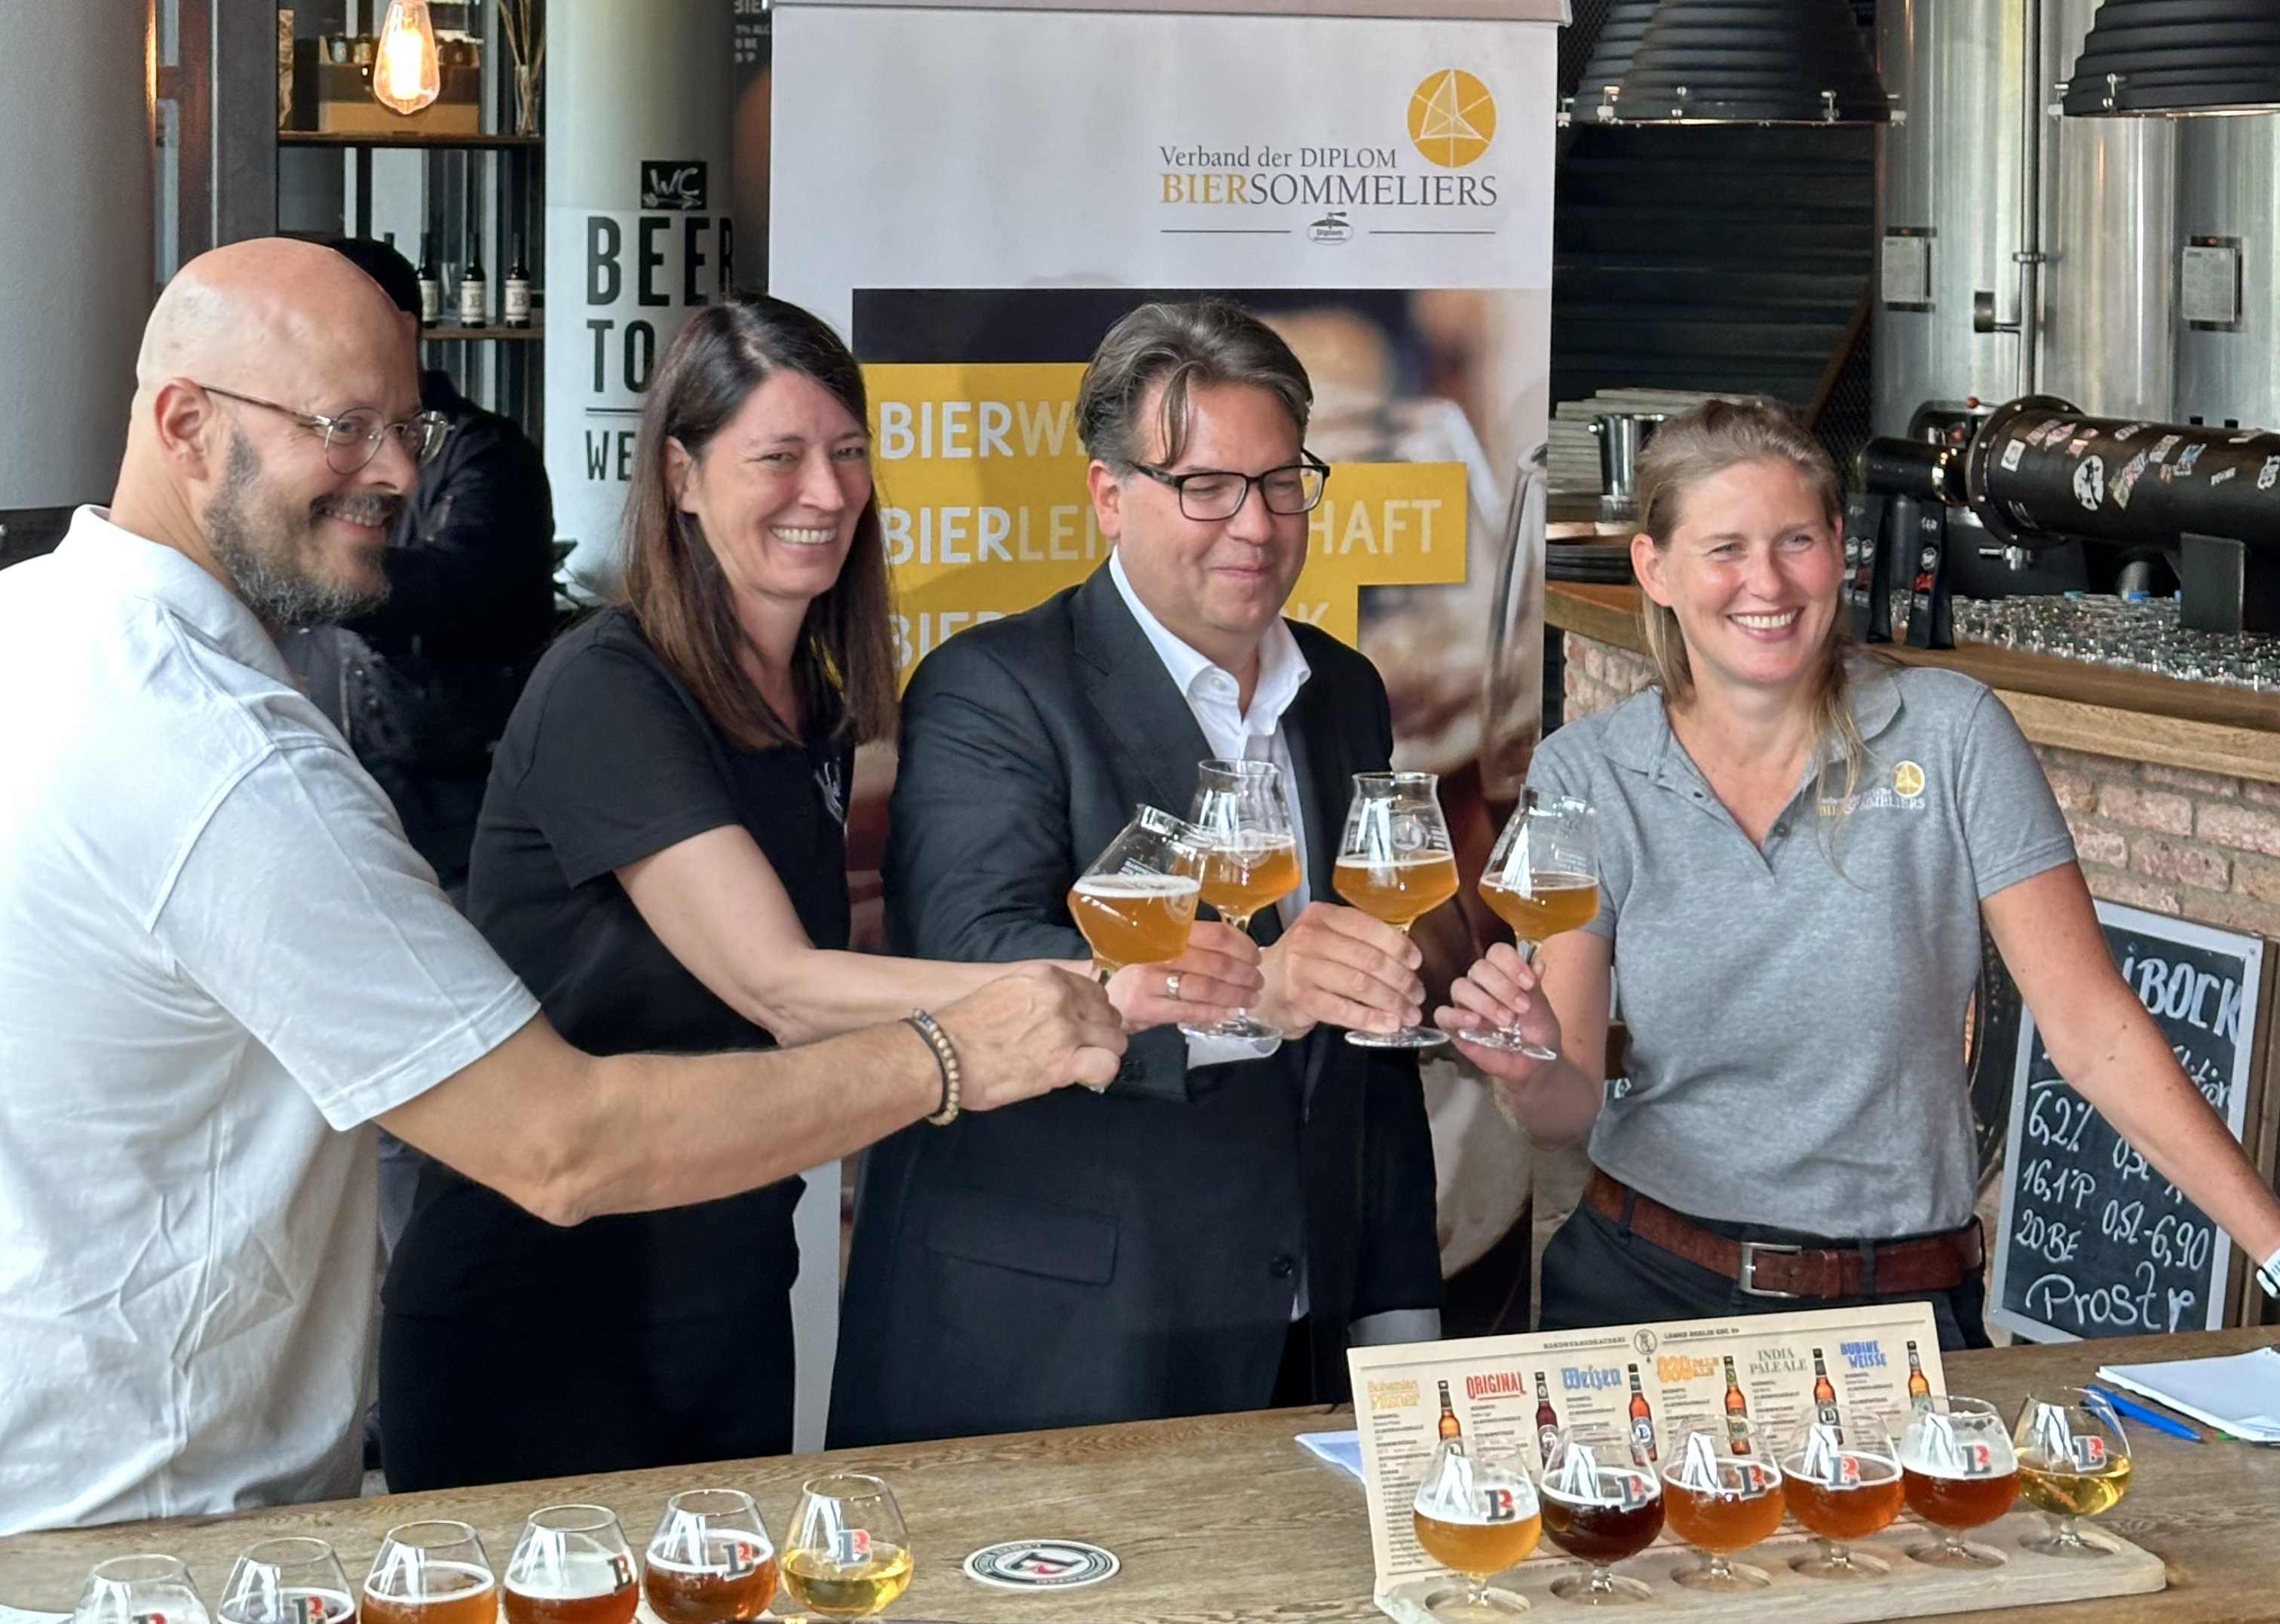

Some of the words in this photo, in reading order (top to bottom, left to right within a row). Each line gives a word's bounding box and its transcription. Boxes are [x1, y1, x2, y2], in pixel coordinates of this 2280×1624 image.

[1160, 146, 1250, 169] Verband
[1258, 146, 1292, 168] der
[1301, 148, 1396, 169] DIPLOM
[650, 167, 700, 198] WC
[1160, 173, 1497, 207] BIERSOMMELIERS
[587, 216, 733, 307] BEER
[585, 430, 635, 481] WE
[1749, 1360, 1780, 1375] PALE
[1781, 1358, 1808, 1371] ALE
[1758, 1347, 1795, 1362] INDIA
[1466, 1371, 1527, 1399] ORIGINAL
